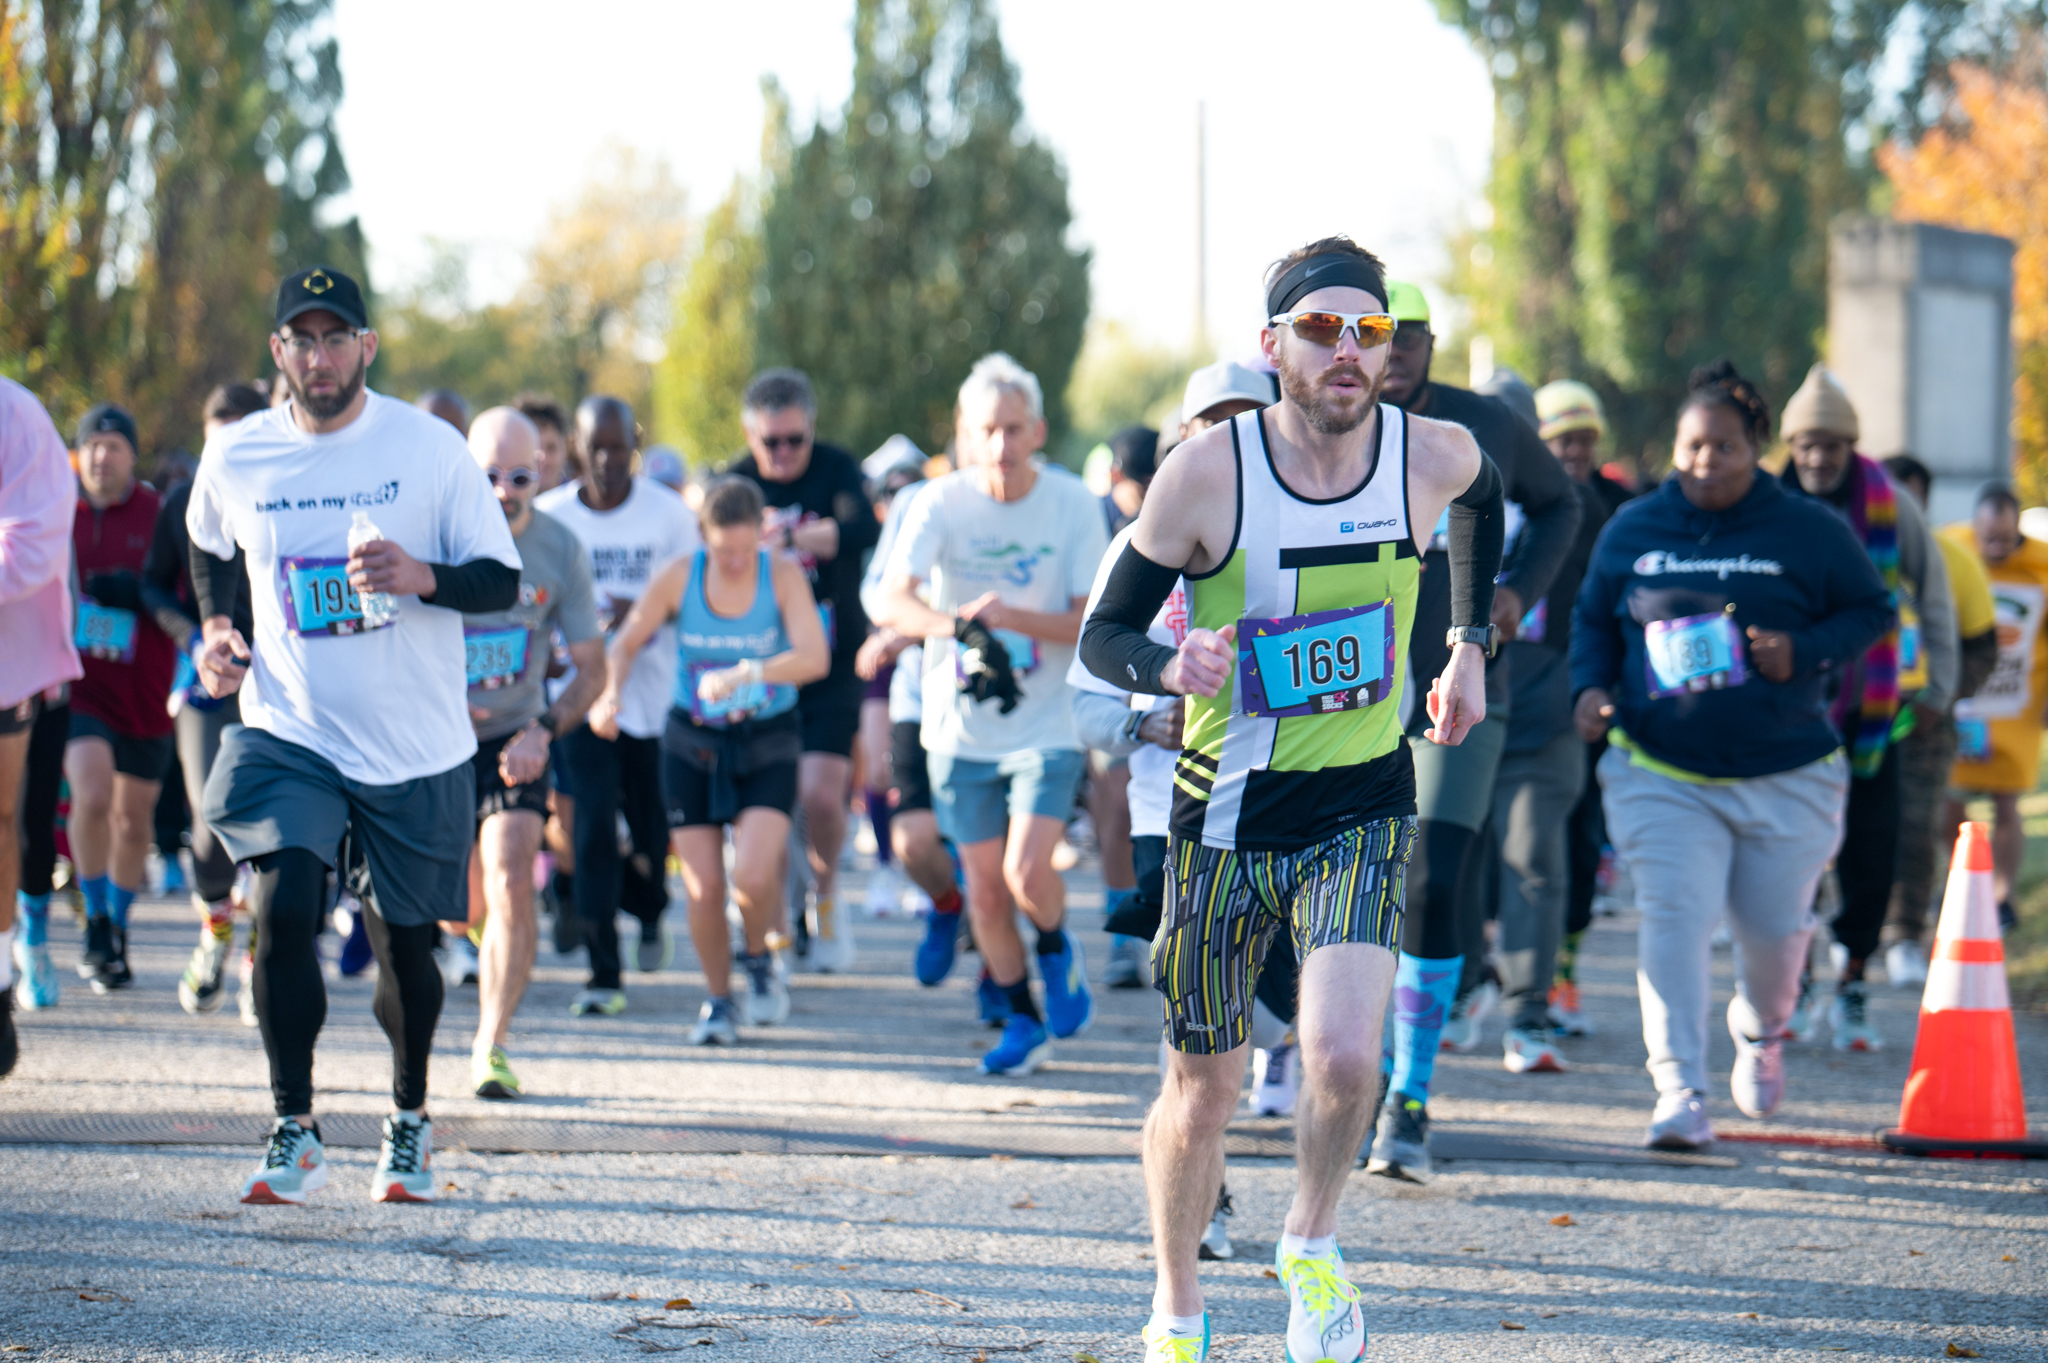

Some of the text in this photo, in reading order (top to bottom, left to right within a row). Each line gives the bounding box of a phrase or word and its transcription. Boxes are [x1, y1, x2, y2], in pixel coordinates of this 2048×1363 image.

[323, 497, 346, 511] my
[1632, 549, 1784, 581] Champion
[1282, 635, 1362, 689] 169
